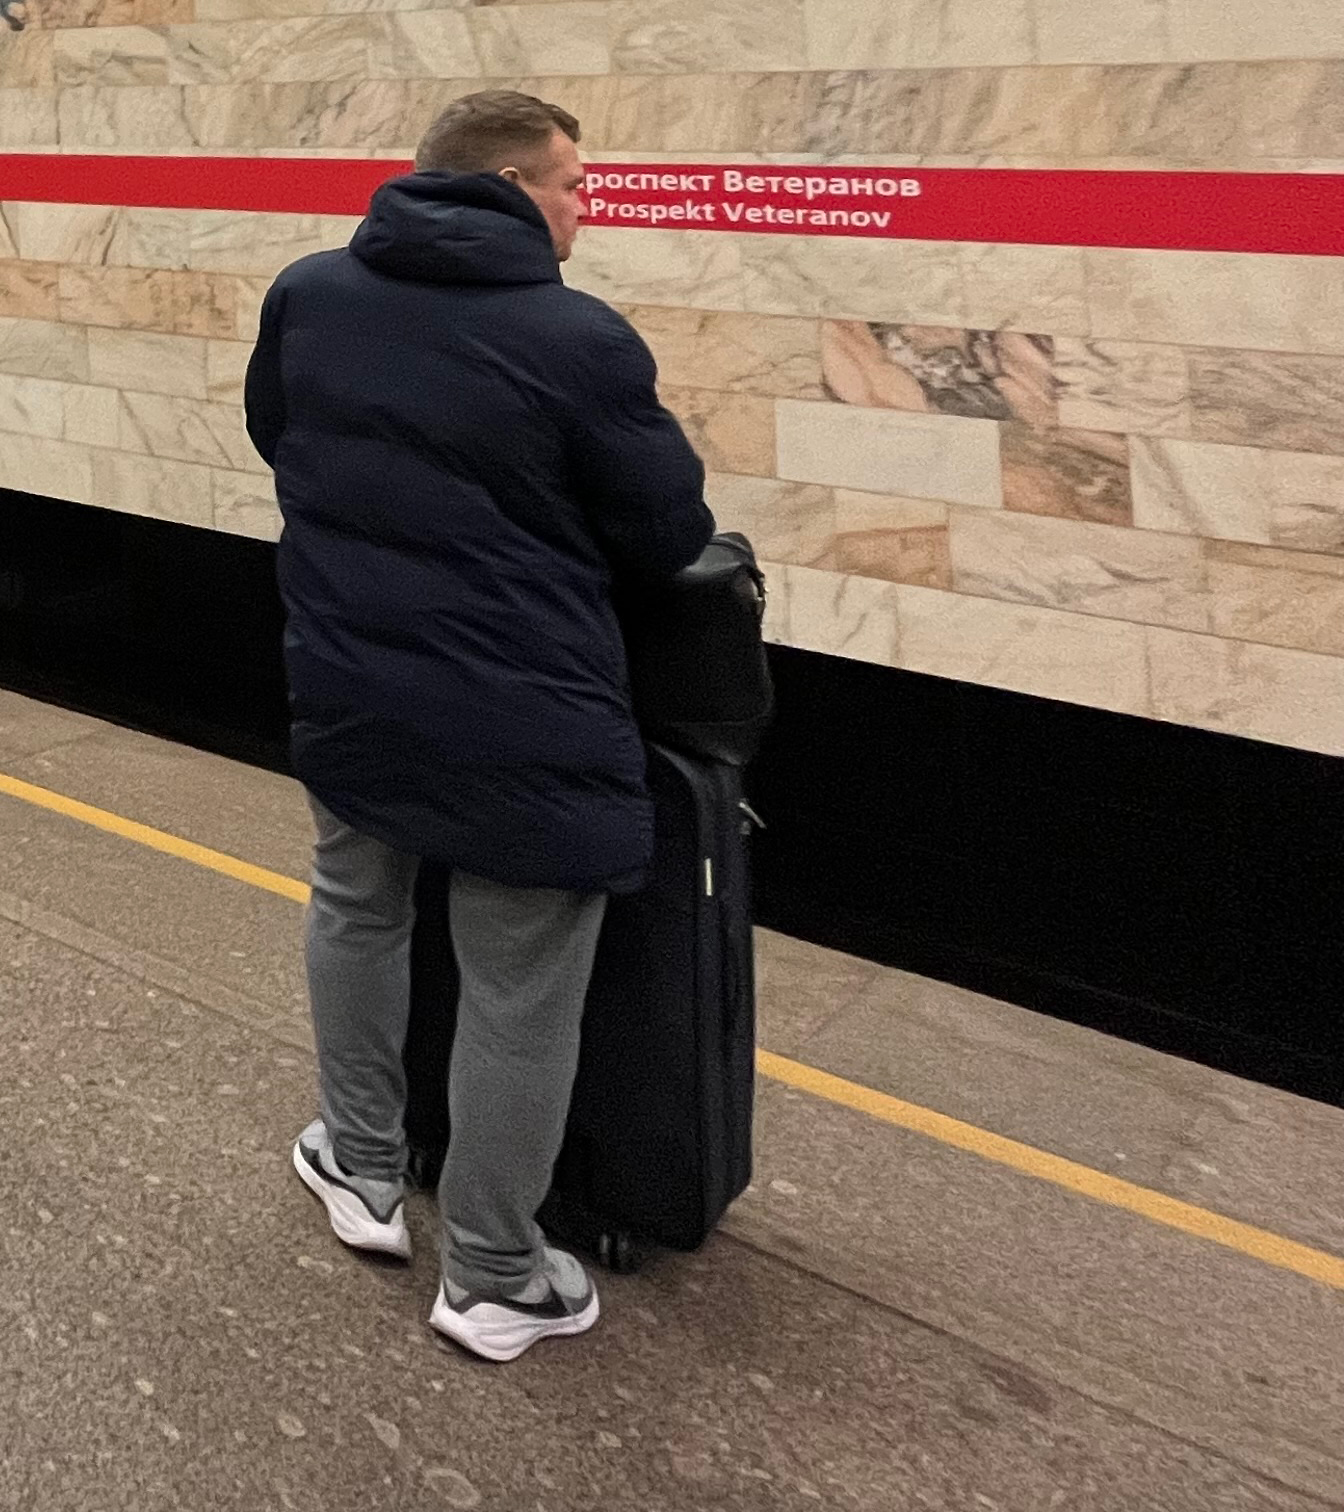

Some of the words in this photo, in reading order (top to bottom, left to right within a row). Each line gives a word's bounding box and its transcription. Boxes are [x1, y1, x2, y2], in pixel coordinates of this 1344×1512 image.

[585, 173, 716, 194] роспект
[723, 170, 921, 200] Ветеранов
[590, 198, 716, 224] Prospekt
[721, 202, 892, 227] Veteranov
